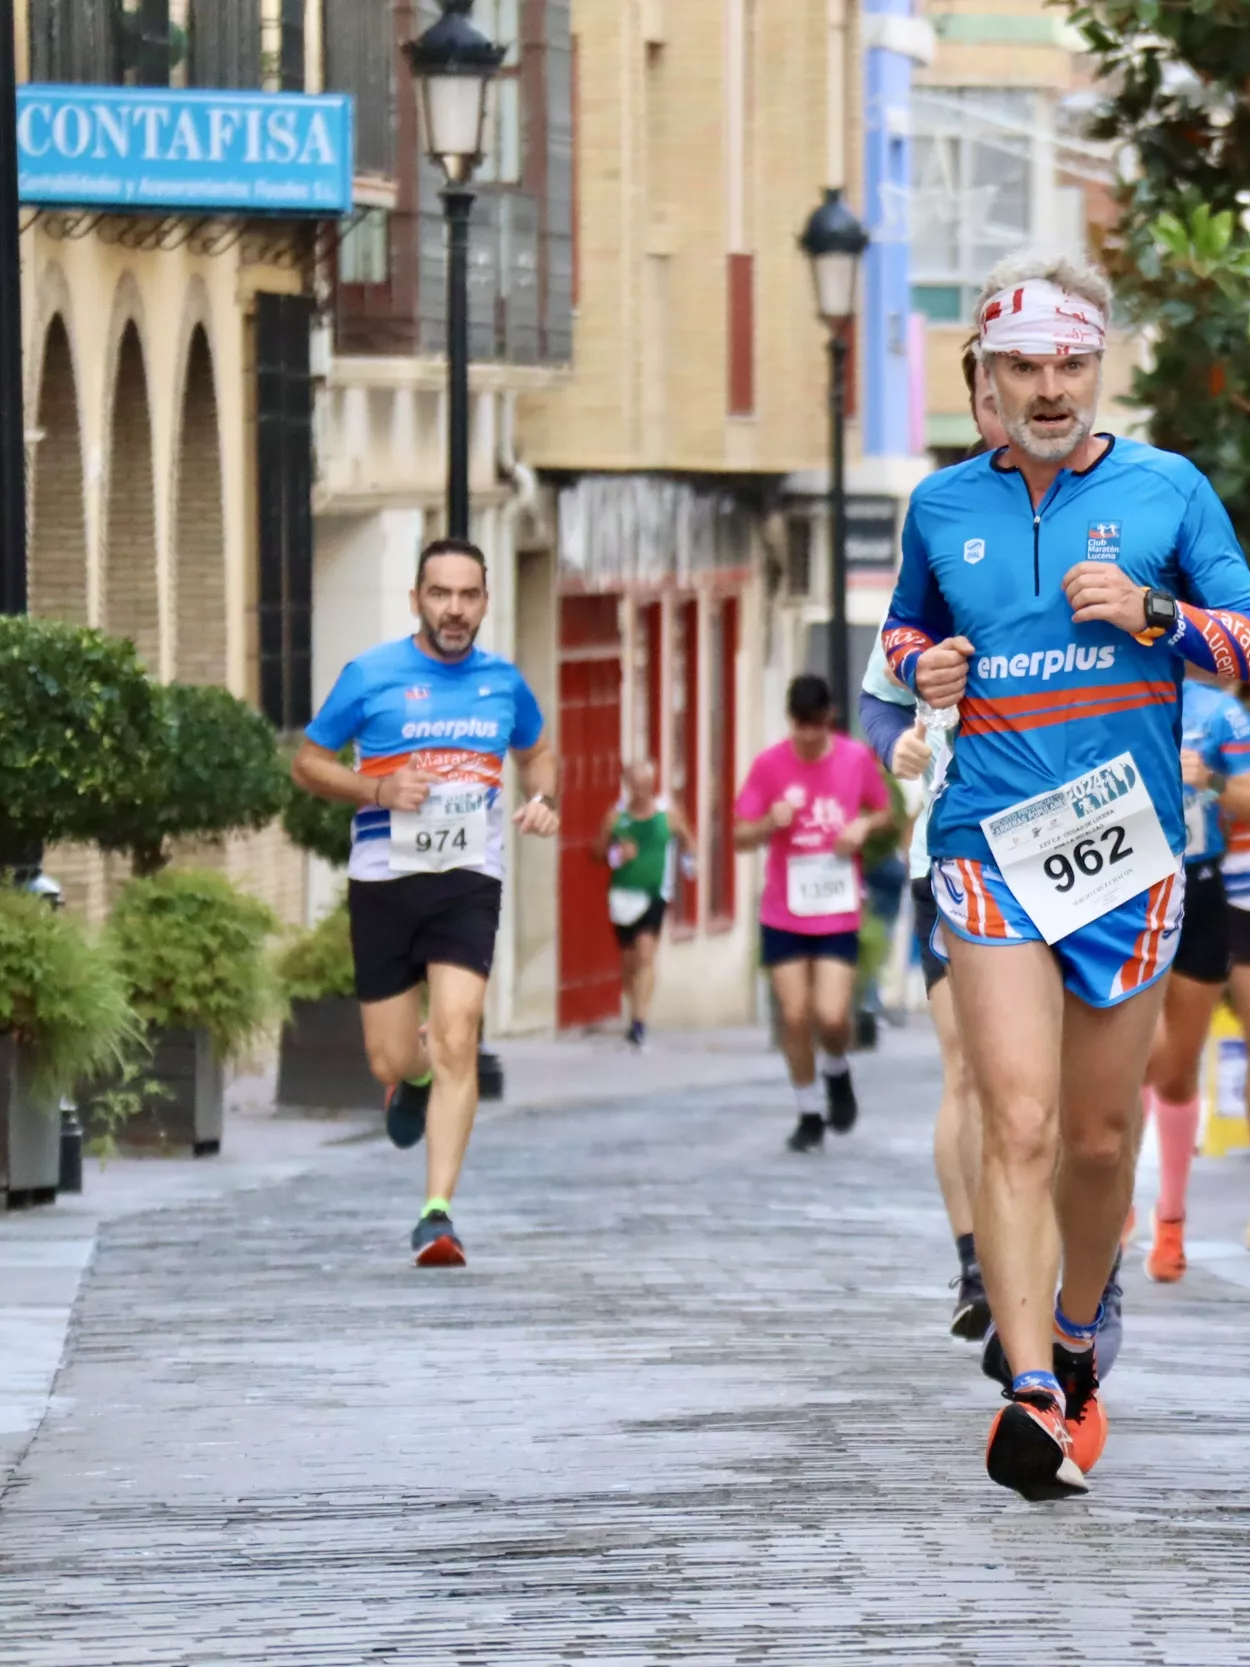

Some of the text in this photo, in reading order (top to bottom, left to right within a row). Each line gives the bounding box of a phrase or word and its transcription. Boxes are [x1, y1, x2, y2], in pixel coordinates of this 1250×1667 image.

[17, 104, 337, 163] CONTAFISA
[1088, 538, 1107, 546] Club
[1088, 545, 1120, 553] Maratón
[1088, 552, 1116, 560] Lucena
[977, 643, 1115, 680] enerplus
[401, 718, 498, 741] enerplus
[415, 827, 468, 853] 974
[1043, 825, 1134, 893] 962
